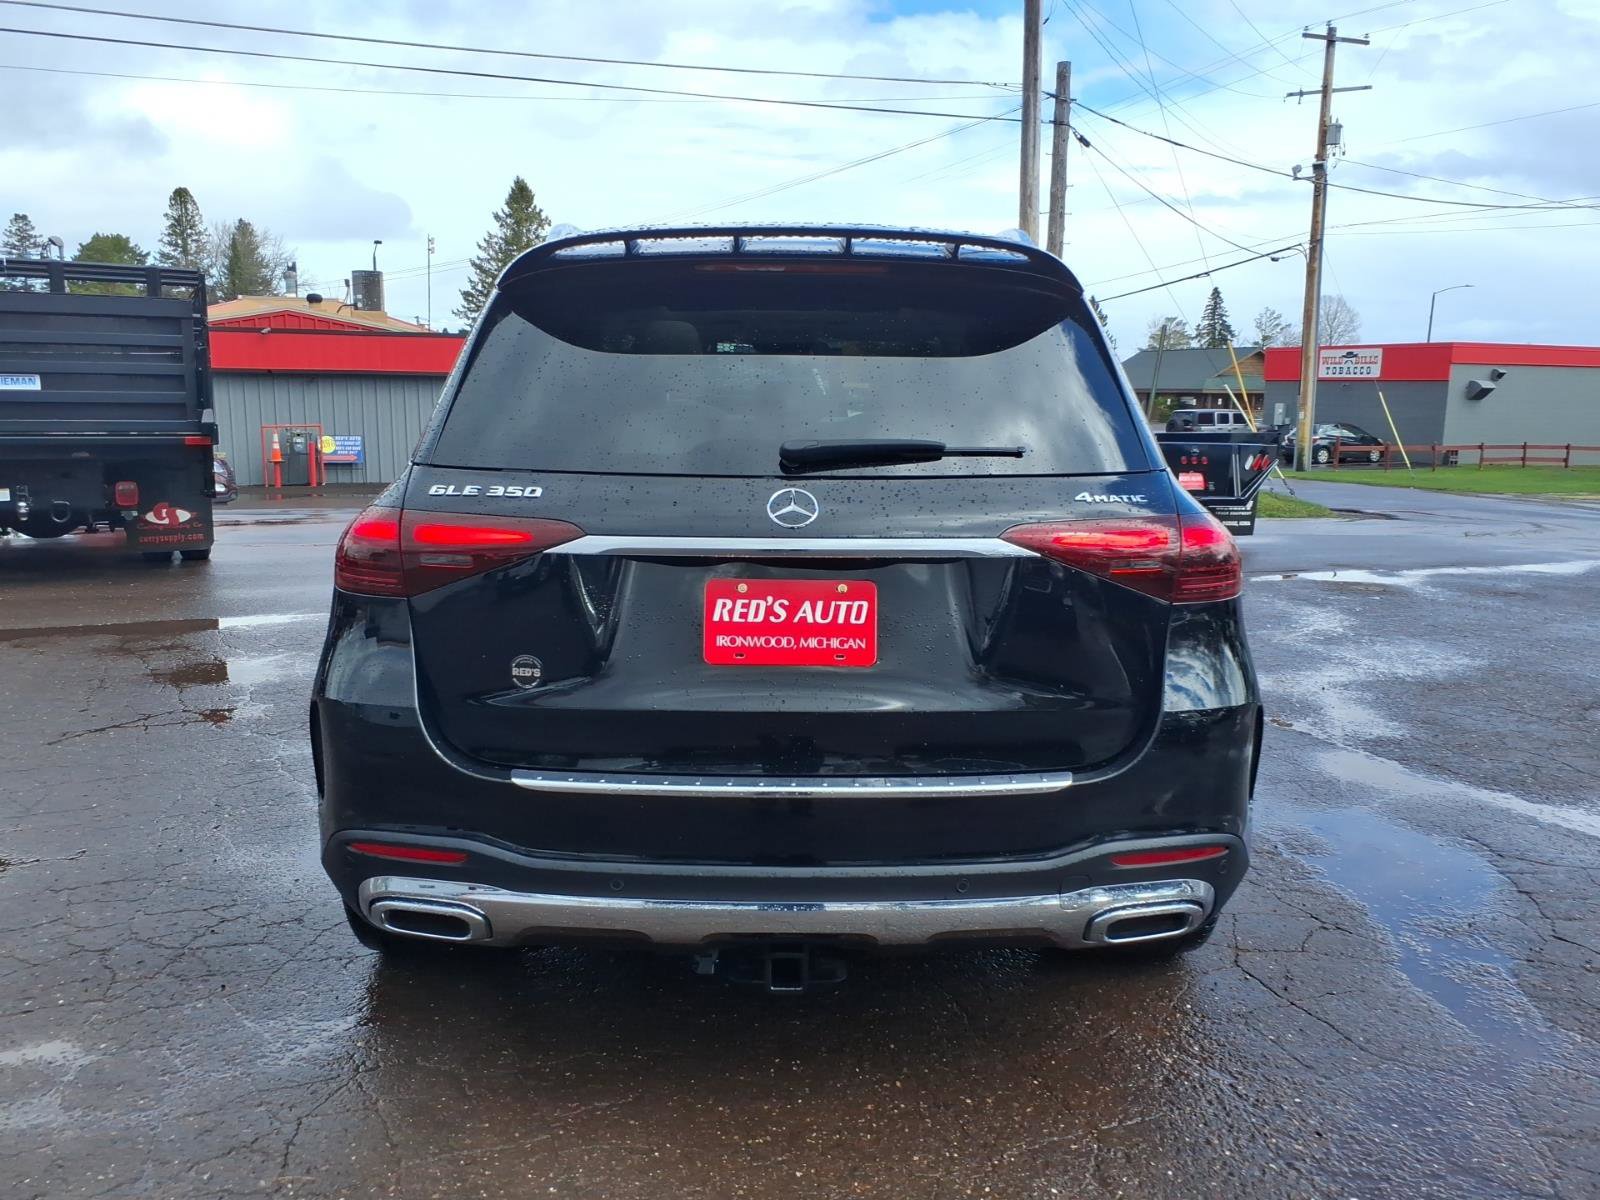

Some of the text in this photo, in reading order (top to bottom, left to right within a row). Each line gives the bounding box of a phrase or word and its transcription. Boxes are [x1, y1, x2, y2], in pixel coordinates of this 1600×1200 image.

[1325, 366, 1371, 375] TOBACCO
[428, 484, 543, 498] GLE 350
[1074, 491, 1149, 504] 4MATIC
[139, 533, 205, 544] currysupply.com
[712, 595, 869, 625] RED'S AUTO
[715, 634, 867, 650] IRONWOOD, MICHIGAN
[512, 667, 541, 677] RED'S
